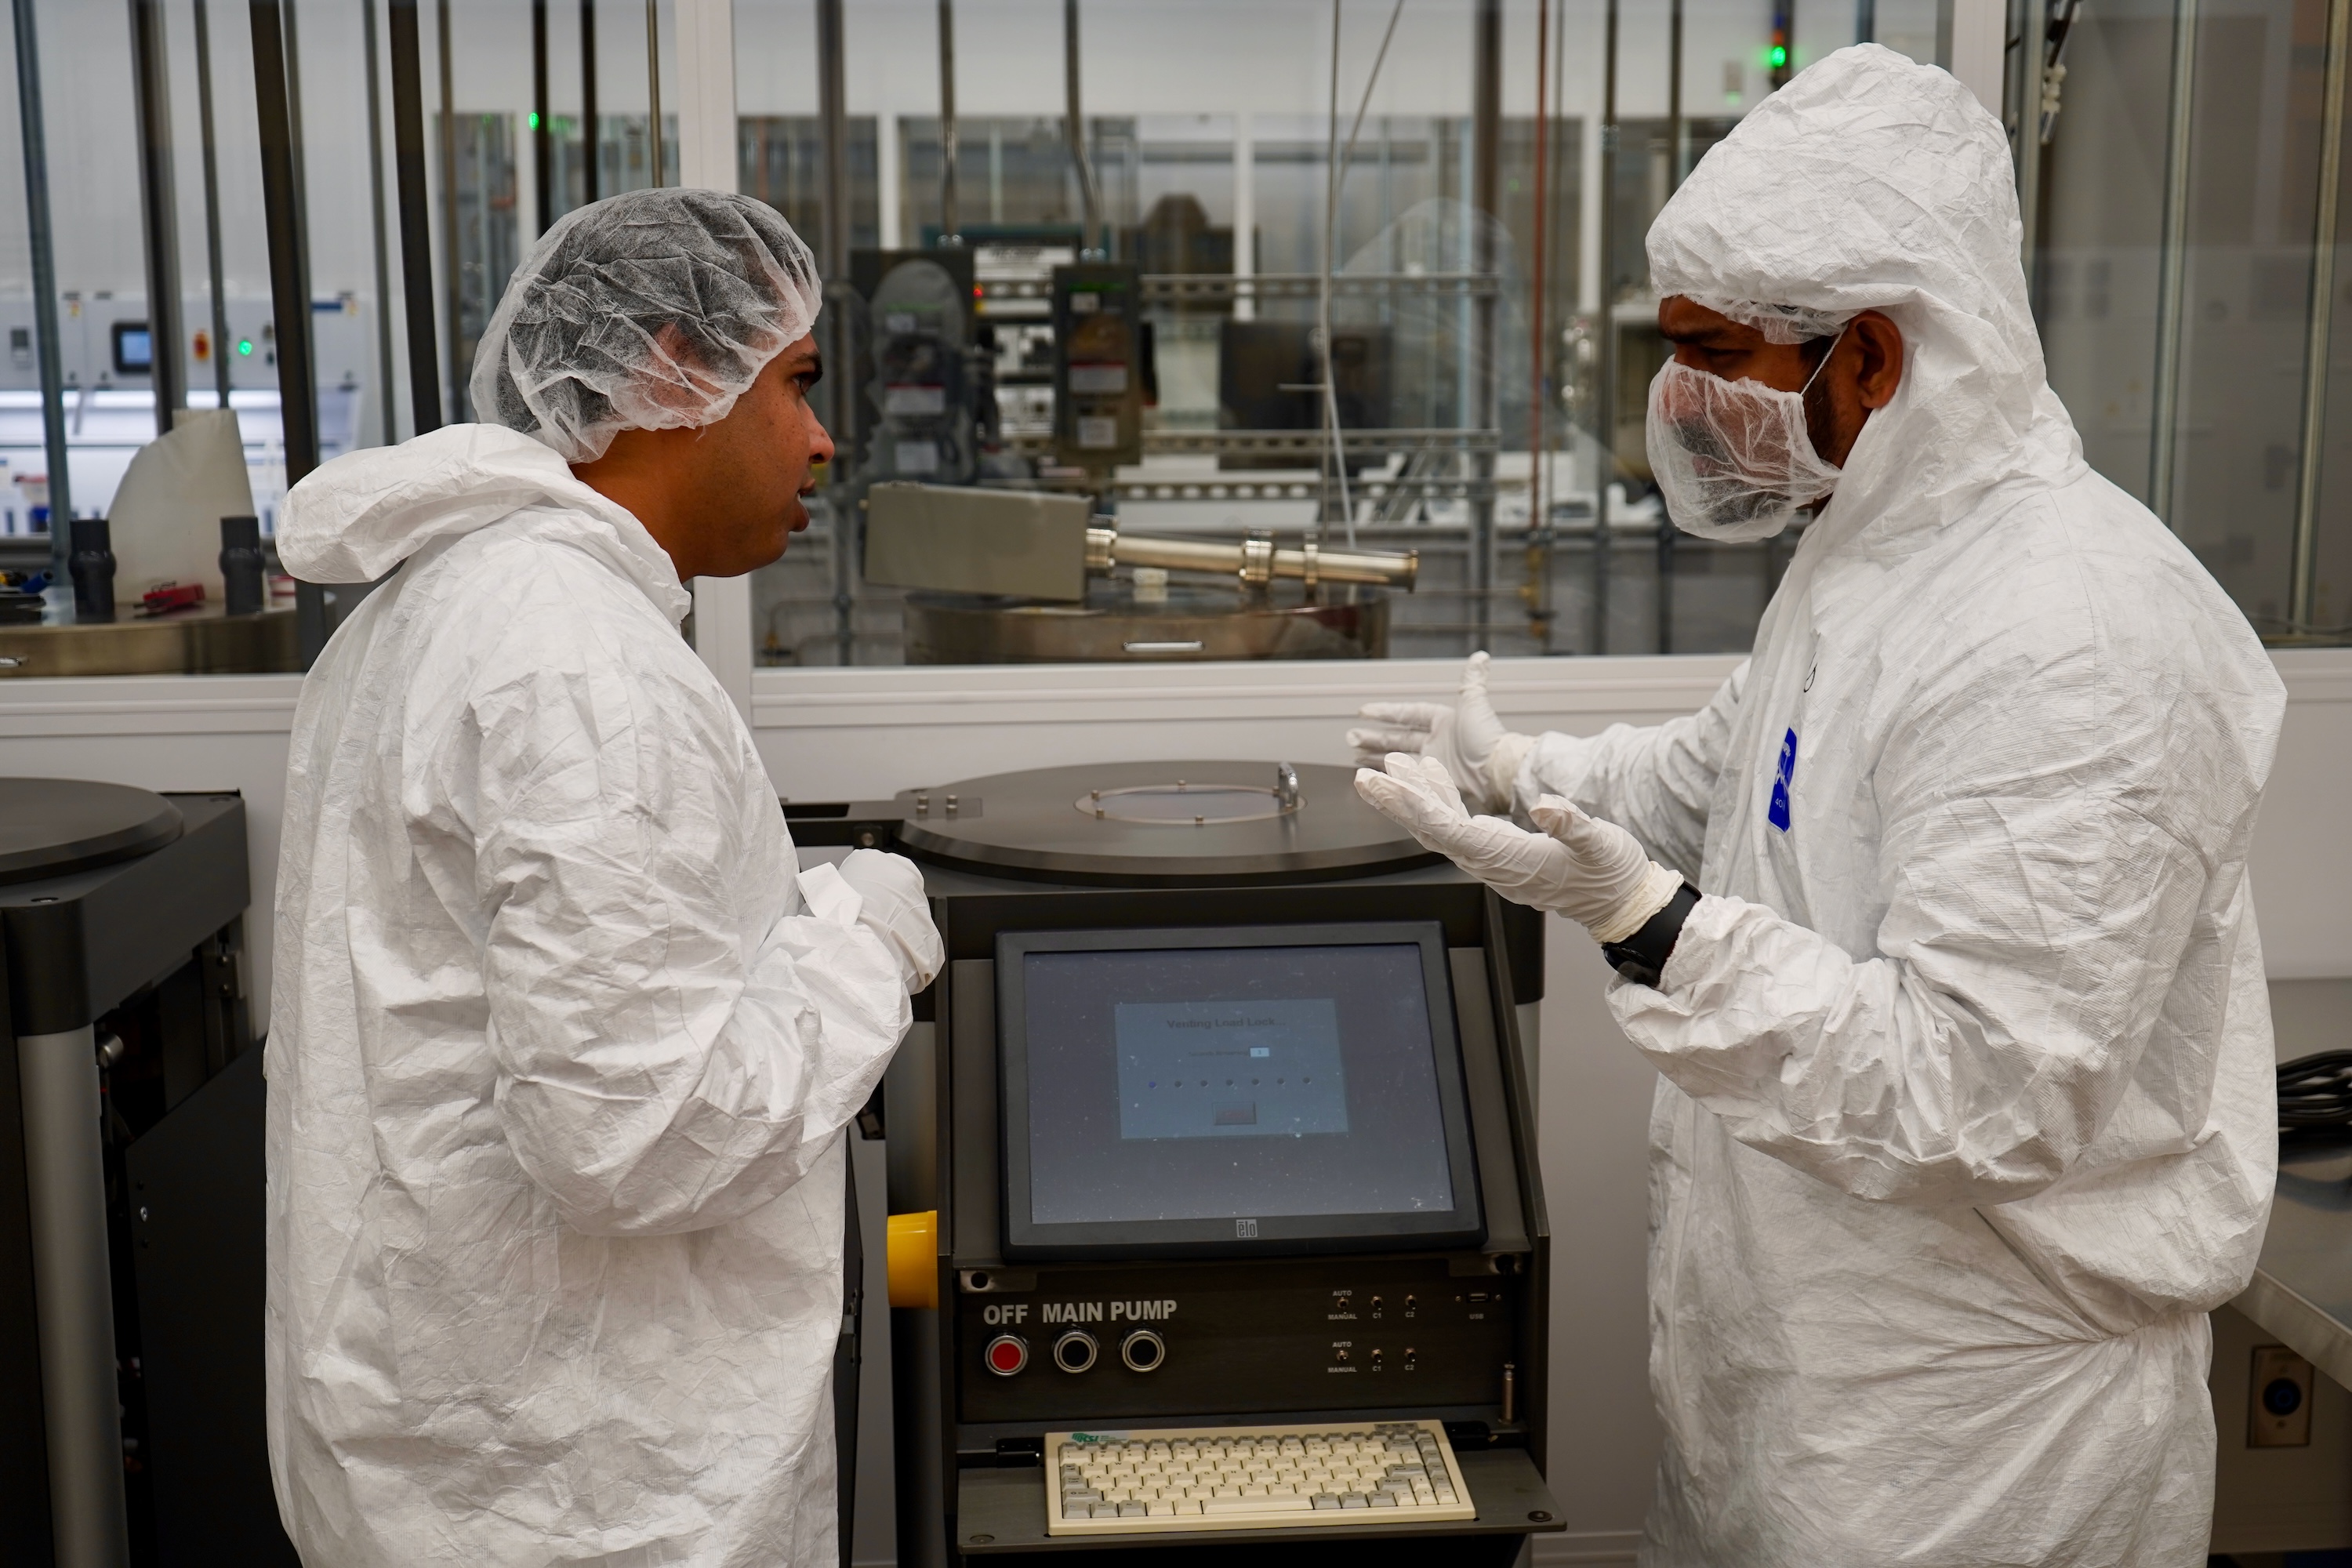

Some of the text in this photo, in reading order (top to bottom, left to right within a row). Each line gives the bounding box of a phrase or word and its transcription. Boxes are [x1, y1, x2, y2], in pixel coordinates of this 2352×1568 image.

[1167, 1020, 1211, 1029] Venting
[1215, 1018, 1243, 1027] Load
[983, 1304, 1029, 1325] OFF
[1043, 1300, 1178, 1323] MAIN PUMP
